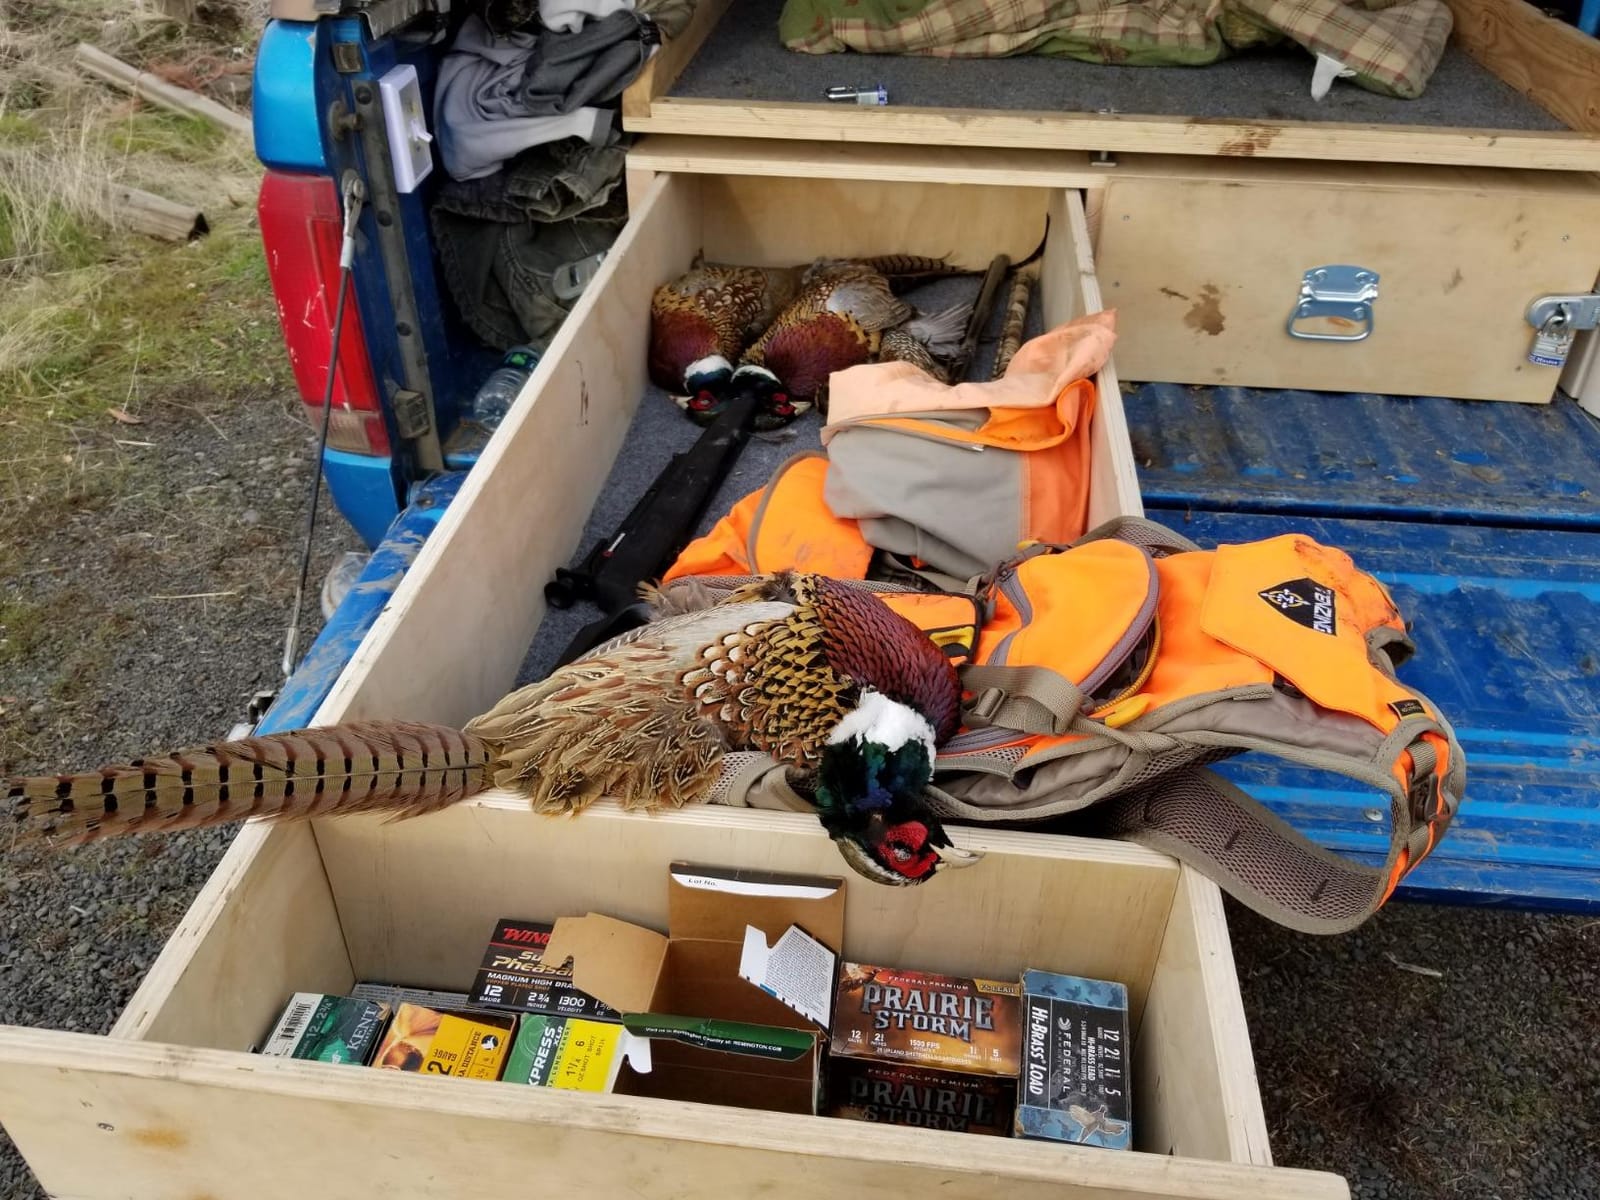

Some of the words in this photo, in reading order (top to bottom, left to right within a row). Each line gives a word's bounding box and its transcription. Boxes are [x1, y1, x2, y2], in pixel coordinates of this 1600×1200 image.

[704, 879, 718, 887] No.
[518, 951, 542, 962] Su
[487, 972, 529, 984] MAGNUM
[531, 979, 553, 987] HIGH
[888, 976, 926, 985] FEDERAL
[929, 981, 969, 990] PREMIUM
[479, 996, 501, 1004] GAUGE
[557, 1006, 582, 1014] VELOCITY
[484, 984, 503, 997] 12
[558, 996, 586, 1007] 1300
[860, 983, 995, 1030] PRAIRIE
[346, 1006, 379, 1050] KENT
[553, 1025, 564, 1047] XLR
[874, 1010, 971, 1042] STORM
[1104, 1029, 1120, 1042] 12
[462, 1031, 482, 1069] DISTANCE
[851, 1029, 861, 1039] 12
[926, 1041, 941, 1049] FPS
[993, 1048, 999, 1057] 5
[1088, 1036, 1096, 1065] HI-BRASS
[433, 1048, 458, 1062] GAUGE
[528, 1026, 556, 1086] XPRESS
[1063, 1032, 1071, 1093] FEDERAL
[427, 1060, 452, 1076] 2
[868, 1068, 921, 1081] FEDERAL
[924, 1076, 979, 1088] PREMIUM
[1087, 1065, 1096, 1081] LEAD
[1029, 1063, 1047, 1096] LOAD
[850, 1076, 995, 1125] PRAIRIE
[1105, 1087, 1121, 1096] 5
[863, 1104, 968, 1132] STORM
